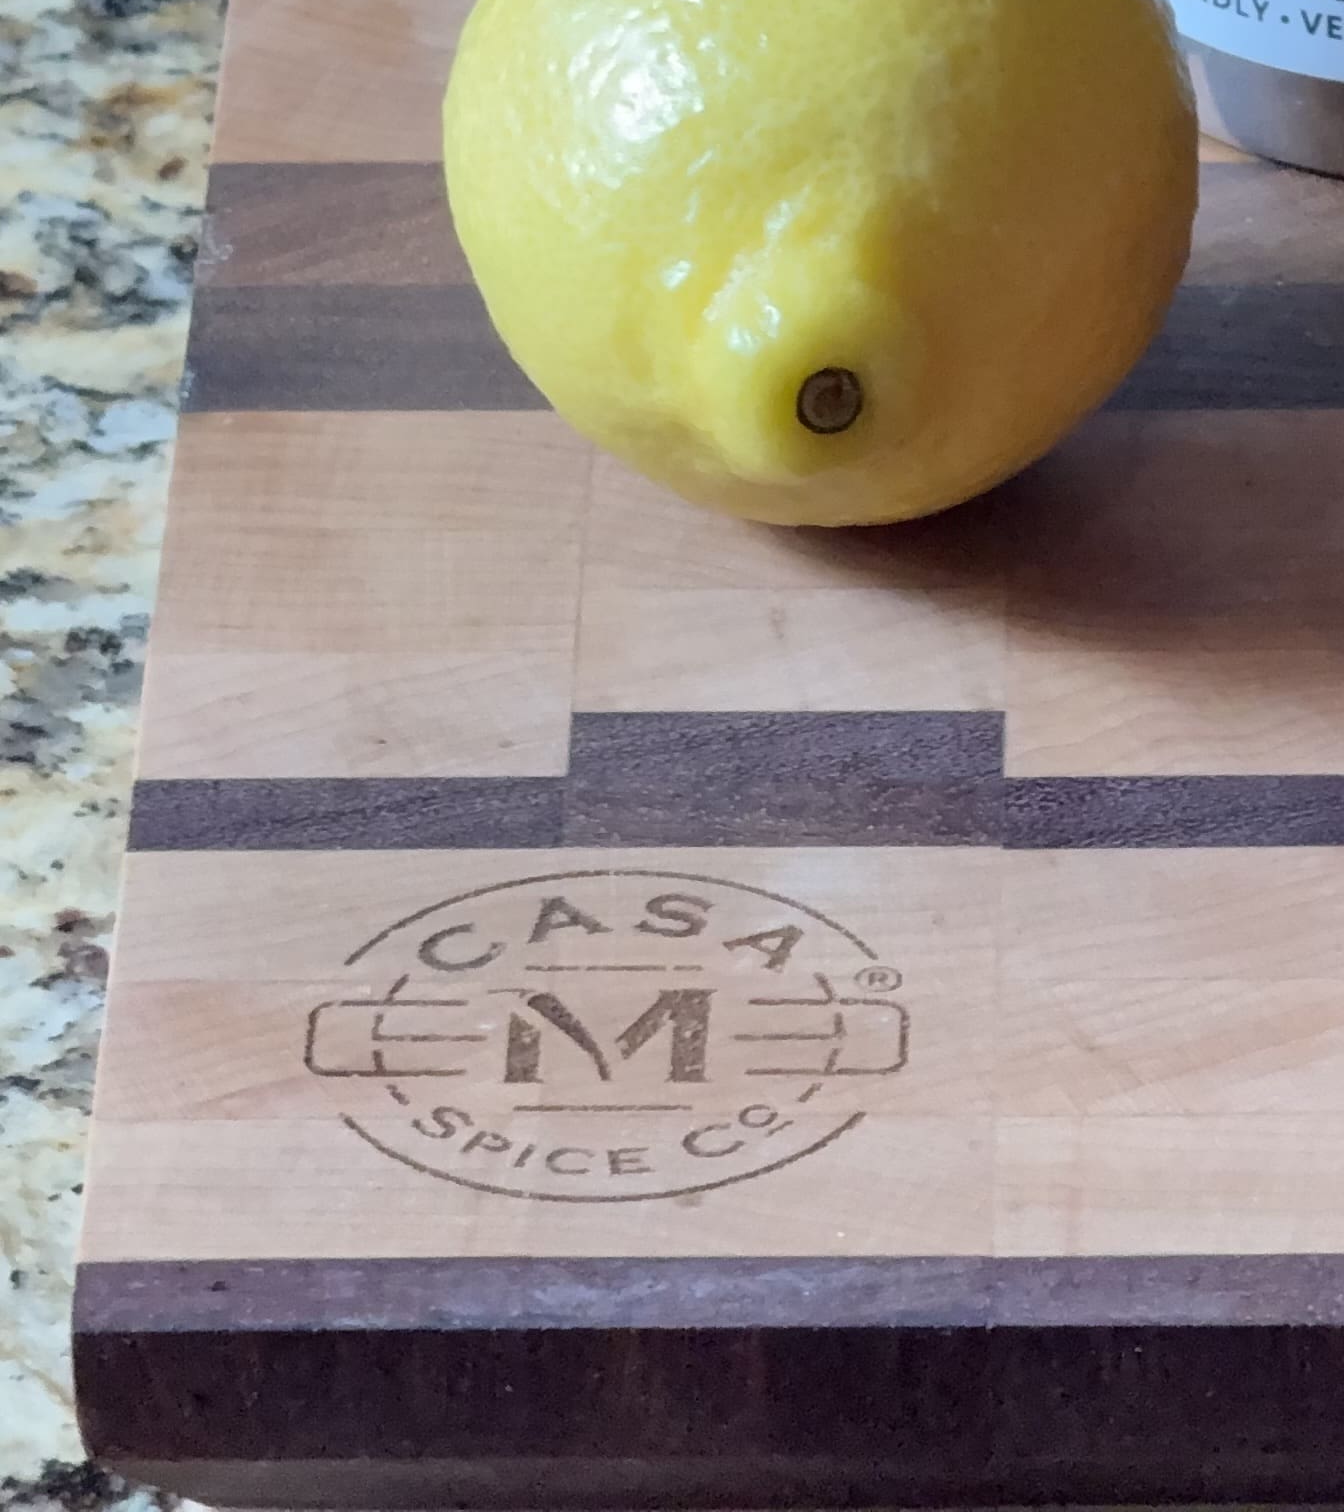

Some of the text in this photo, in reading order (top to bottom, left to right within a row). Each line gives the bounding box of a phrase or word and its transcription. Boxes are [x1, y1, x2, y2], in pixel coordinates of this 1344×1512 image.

[418, 893, 806, 972] CASA
[489, 987, 718, 1084] M
[411, 1105, 656, 1177] SPICE
